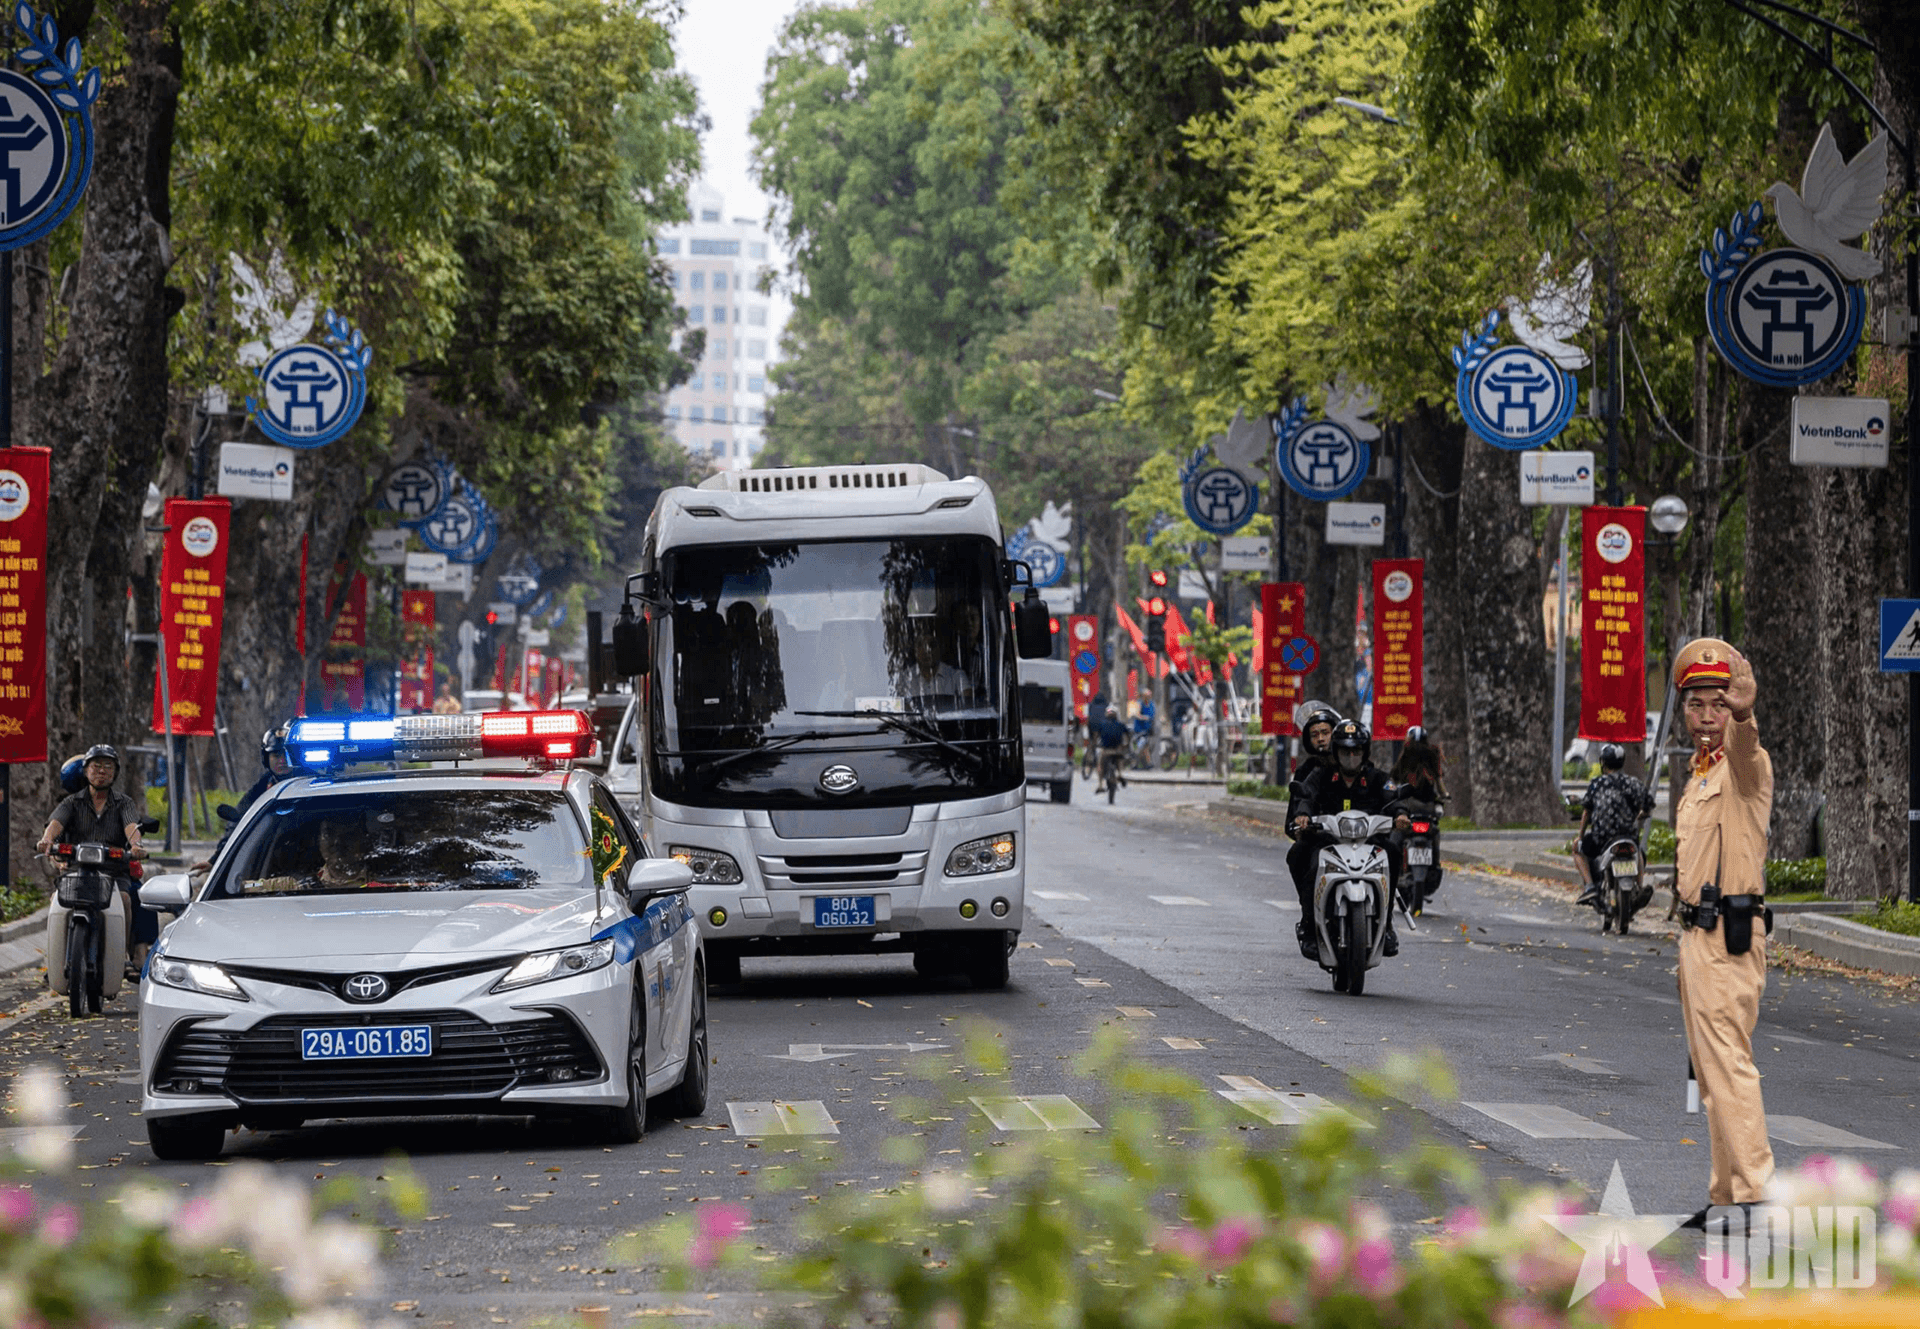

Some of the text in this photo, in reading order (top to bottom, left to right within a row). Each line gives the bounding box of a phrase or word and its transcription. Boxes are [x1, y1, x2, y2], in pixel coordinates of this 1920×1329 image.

[832, 897, 858, 911] 80A
[821, 911, 869, 925] 060.32
[306, 1029, 427, 1056] 29A-061.85
